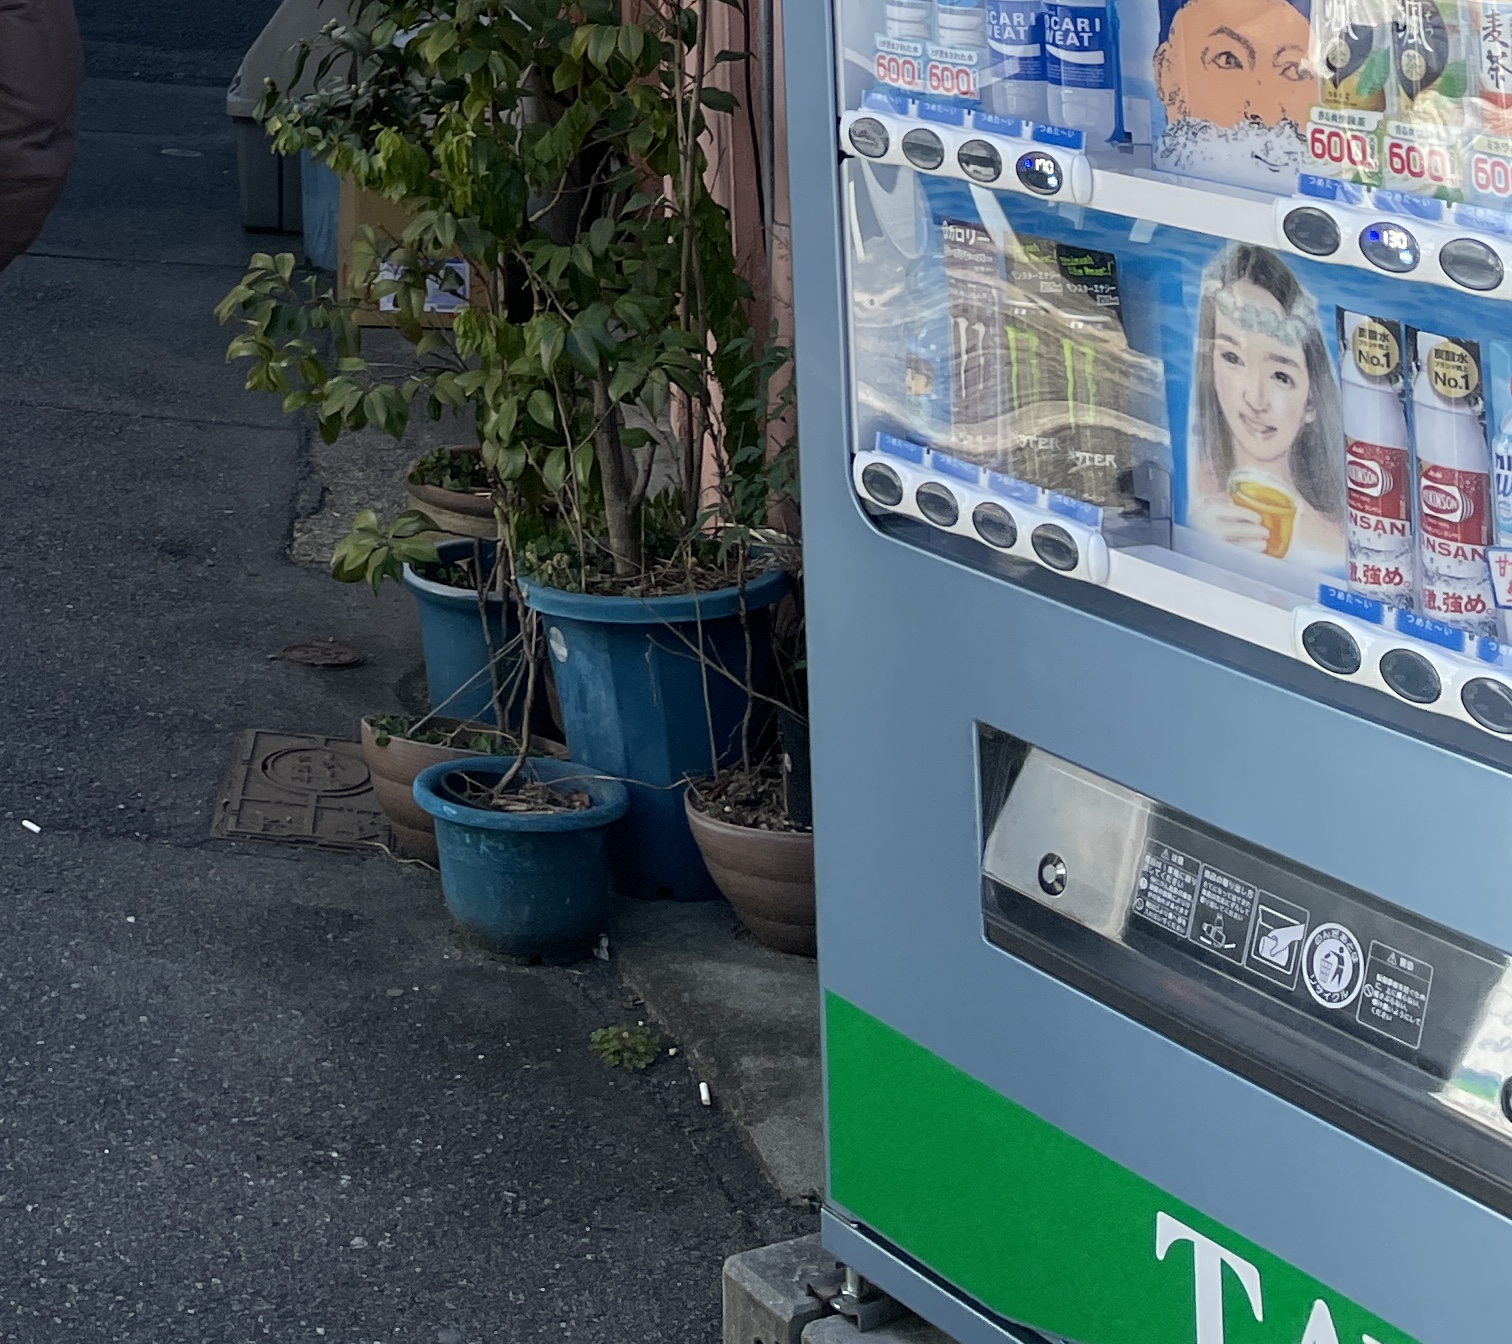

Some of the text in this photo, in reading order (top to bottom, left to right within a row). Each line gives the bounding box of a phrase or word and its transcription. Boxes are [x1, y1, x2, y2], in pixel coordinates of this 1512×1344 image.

[1480, 7, 1512, 91] 麦茶
[876, 53, 916, 88] 600
[928, 63, 972, 97] 600
[1310, 126, 1368, 168] 600
[1387, 140, 1447, 183] 600
[1357, 348, 1392, 370] No.1
[1433, 369, 1471, 392] No.1
[1405, 613, 1453, 637] つめた〜い
